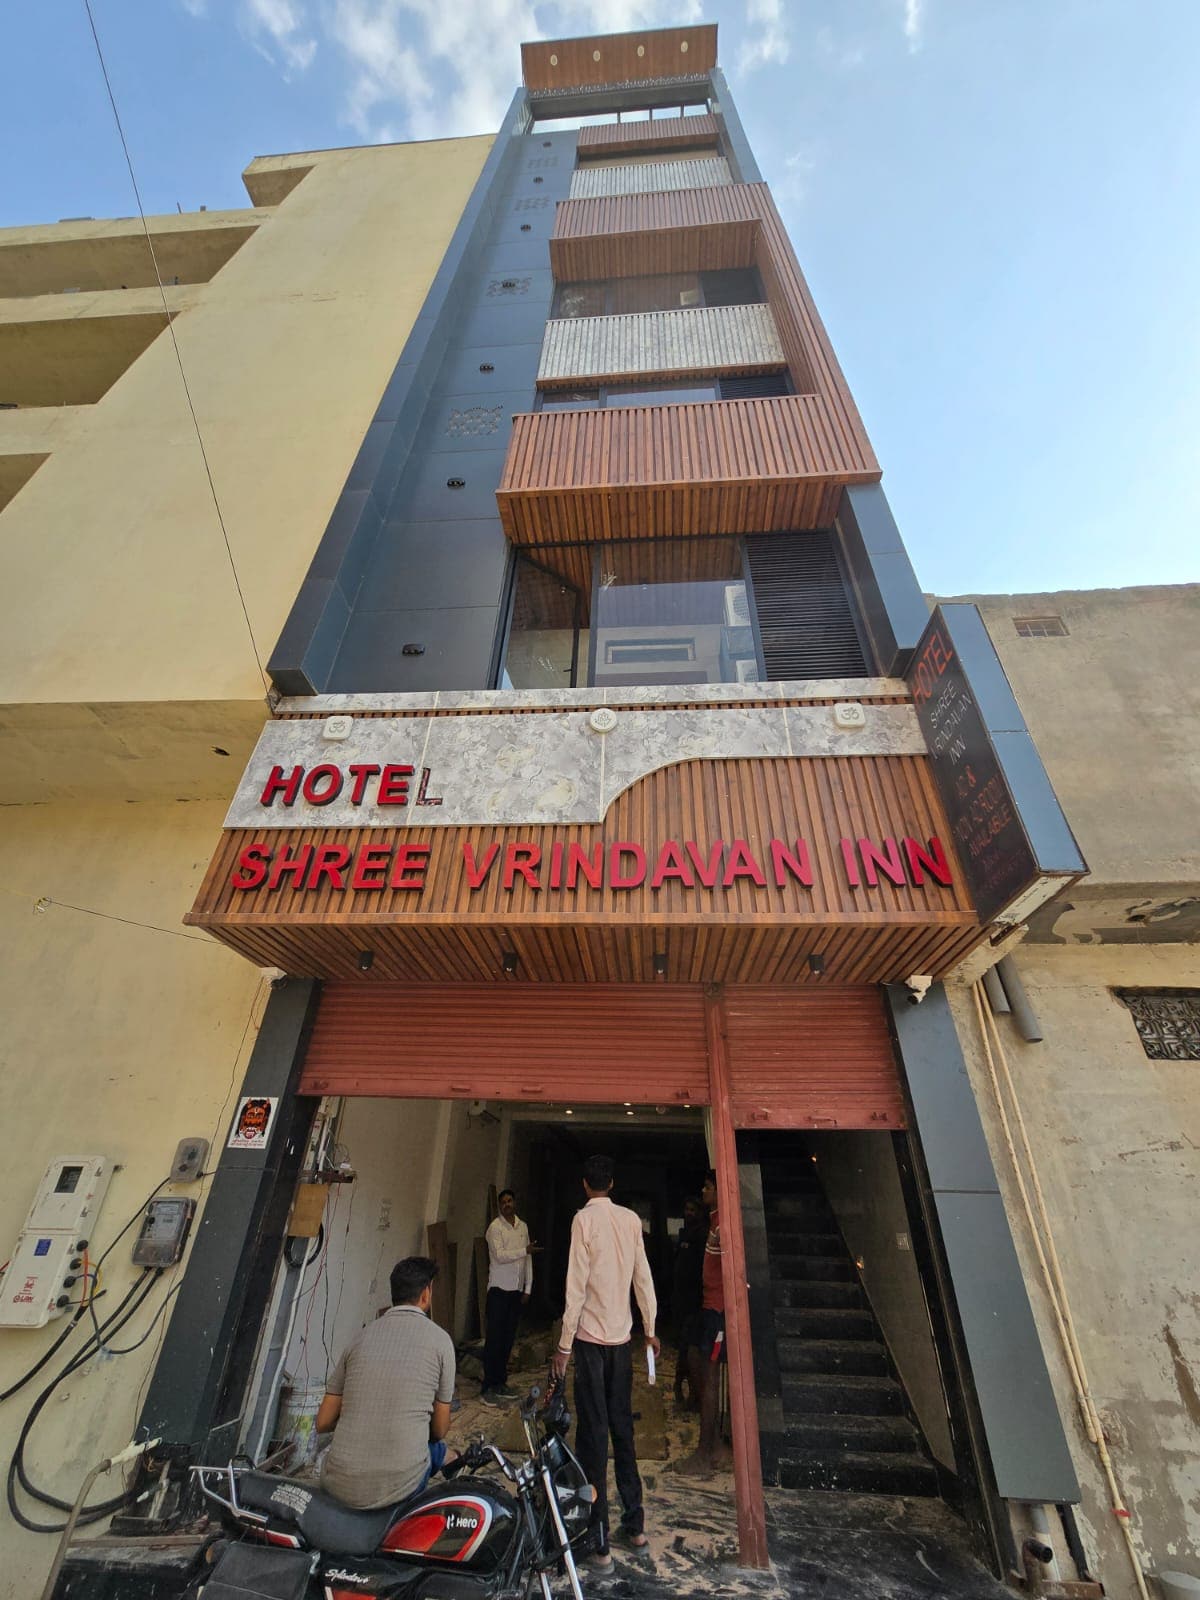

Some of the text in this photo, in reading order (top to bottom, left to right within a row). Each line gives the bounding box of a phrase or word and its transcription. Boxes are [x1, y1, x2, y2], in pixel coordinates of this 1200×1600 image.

[911, 629, 954, 706] HOTEL
[930, 680, 957, 729] SHREE
[260, 763, 444, 807] HOTEL
[231, 842, 433, 892] SHREE
[462, 837, 815, 890] VRINDAVAN
[839, 834, 953, 889] INN
[456, 1516, 478, 1529] Hero
